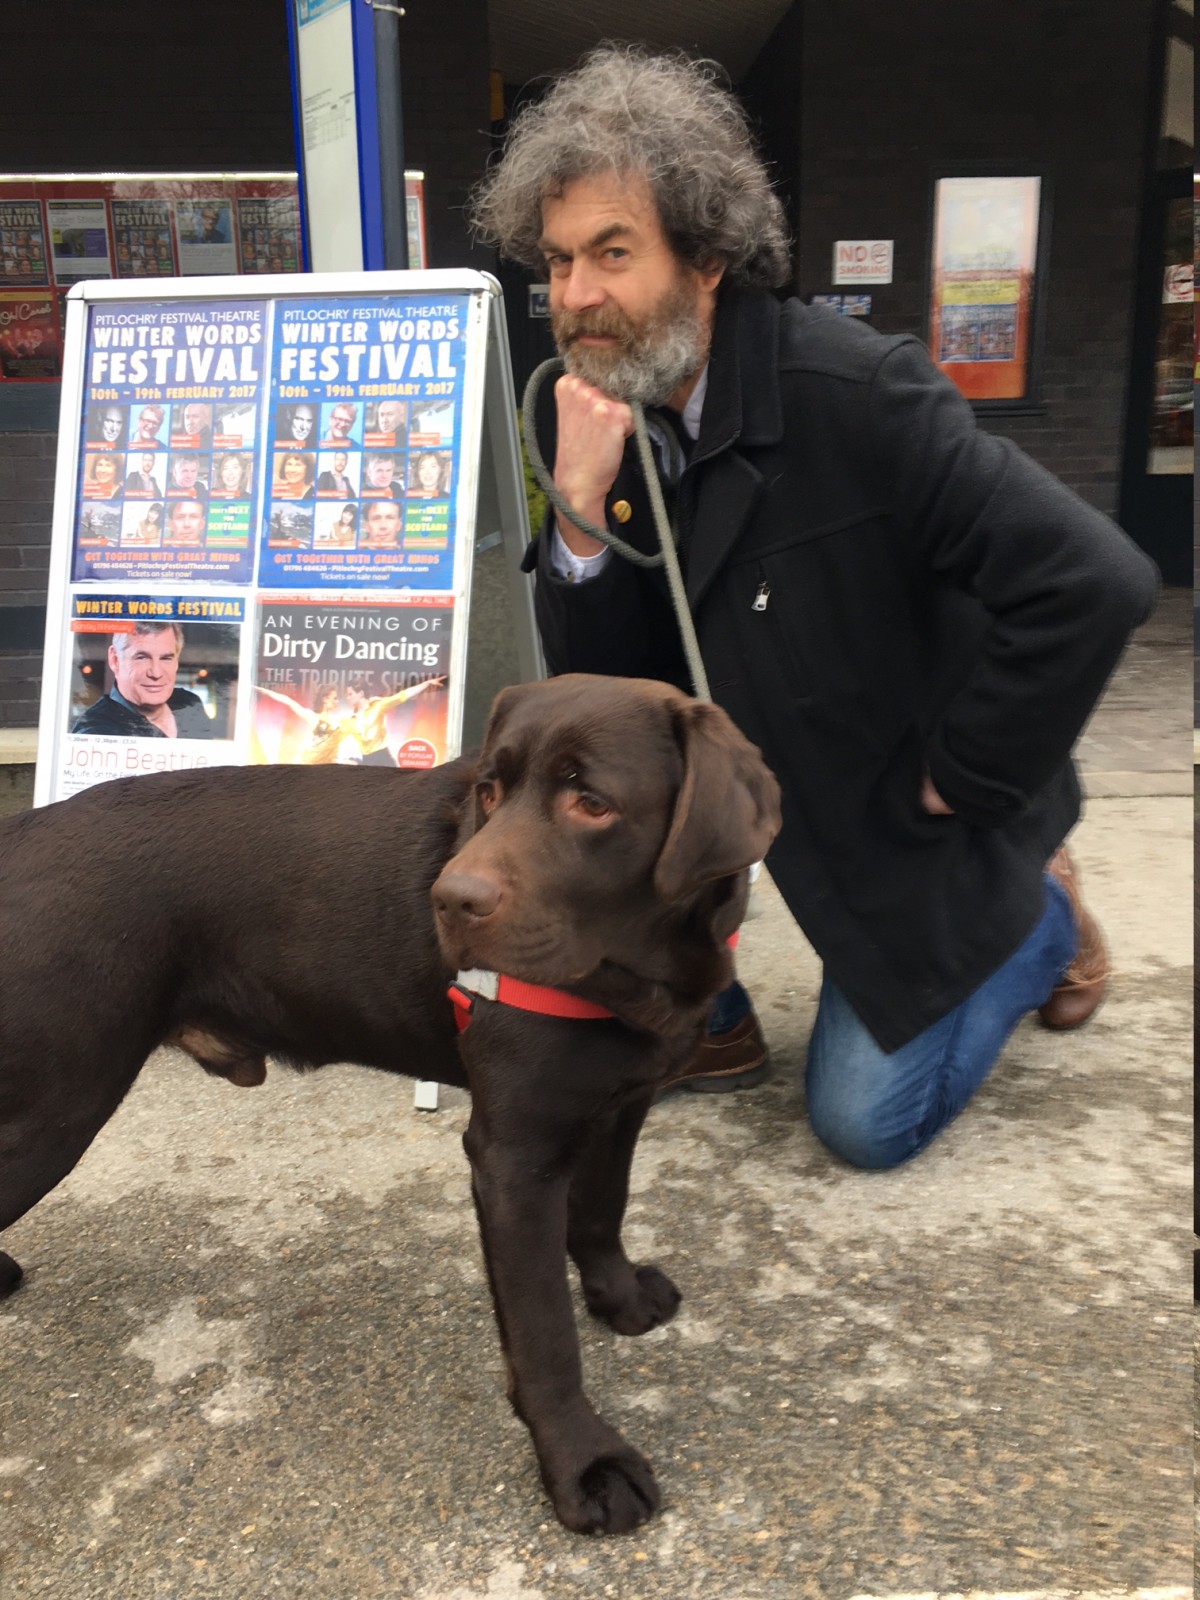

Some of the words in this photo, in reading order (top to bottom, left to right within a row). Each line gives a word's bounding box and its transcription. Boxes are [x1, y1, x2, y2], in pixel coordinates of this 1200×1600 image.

[115, 214, 167, 225] FESTIVAL
[839, 246, 867, 262] NO
[839, 266, 890, 274] SMOKING
[96, 314, 158, 325] PITLOCHRY
[161, 313, 208, 324] FESTIVAL
[210, 310, 261, 322] THEATRE
[284, 309, 349, 320] PITLOCHRY
[353, 308, 403, 319] FESTIVAL
[405, 305, 458, 318] THEATRE
[94, 326, 175, 348] WINTER
[186, 323, 261, 346] WORDS
[282, 321, 368, 344] WINTER
[379, 318, 460, 342] WORDS
[92, 346, 258, 384] FESTIVAL
[280, 342, 457, 382] FESTIVAL
[91, 388, 118, 400] 10th
[135, 388, 161, 400] 19th
[166, 386, 224, 398] FEBRUARY
[228, 385, 257, 398] 2017
[280, 385, 308, 398] 10th
[326, 384, 354, 397] 19th
[359, 383, 420, 396] FEBRUARY
[425, 382, 455, 395] 2017
[84, 552, 101, 562] GET
[104, 552, 150, 562] TOGETHER
[152, 552, 174, 562] WITH
[177, 552, 206, 562] GREAT
[296, 554, 344, 564] TOGETHER
[346, 554, 371, 564] WITH
[374, 554, 404, 564] GREAT
[127, 570, 151, 578] Tickets
[372, 573, 390, 581] now!
[76, 601, 123, 614] WINTER
[128, 602, 173, 615] WORDS
[178, 602, 242, 616] FESTIVAL
[264, 615, 293, 628] AN
[304, 615, 400, 631] EVENING
[412, 617, 442, 632] OF
[263, 632, 327, 662] Dirty
[335, 635, 440, 667] Dancing
[265, 668, 294, 682] THE
[300, 668, 374, 694] TRIBUTE
[380, 671, 440, 698] SHOW
[66, 746, 118, 768] John
[126, 748, 208, 770] Beattie
[64, 770, 74, 778] My
